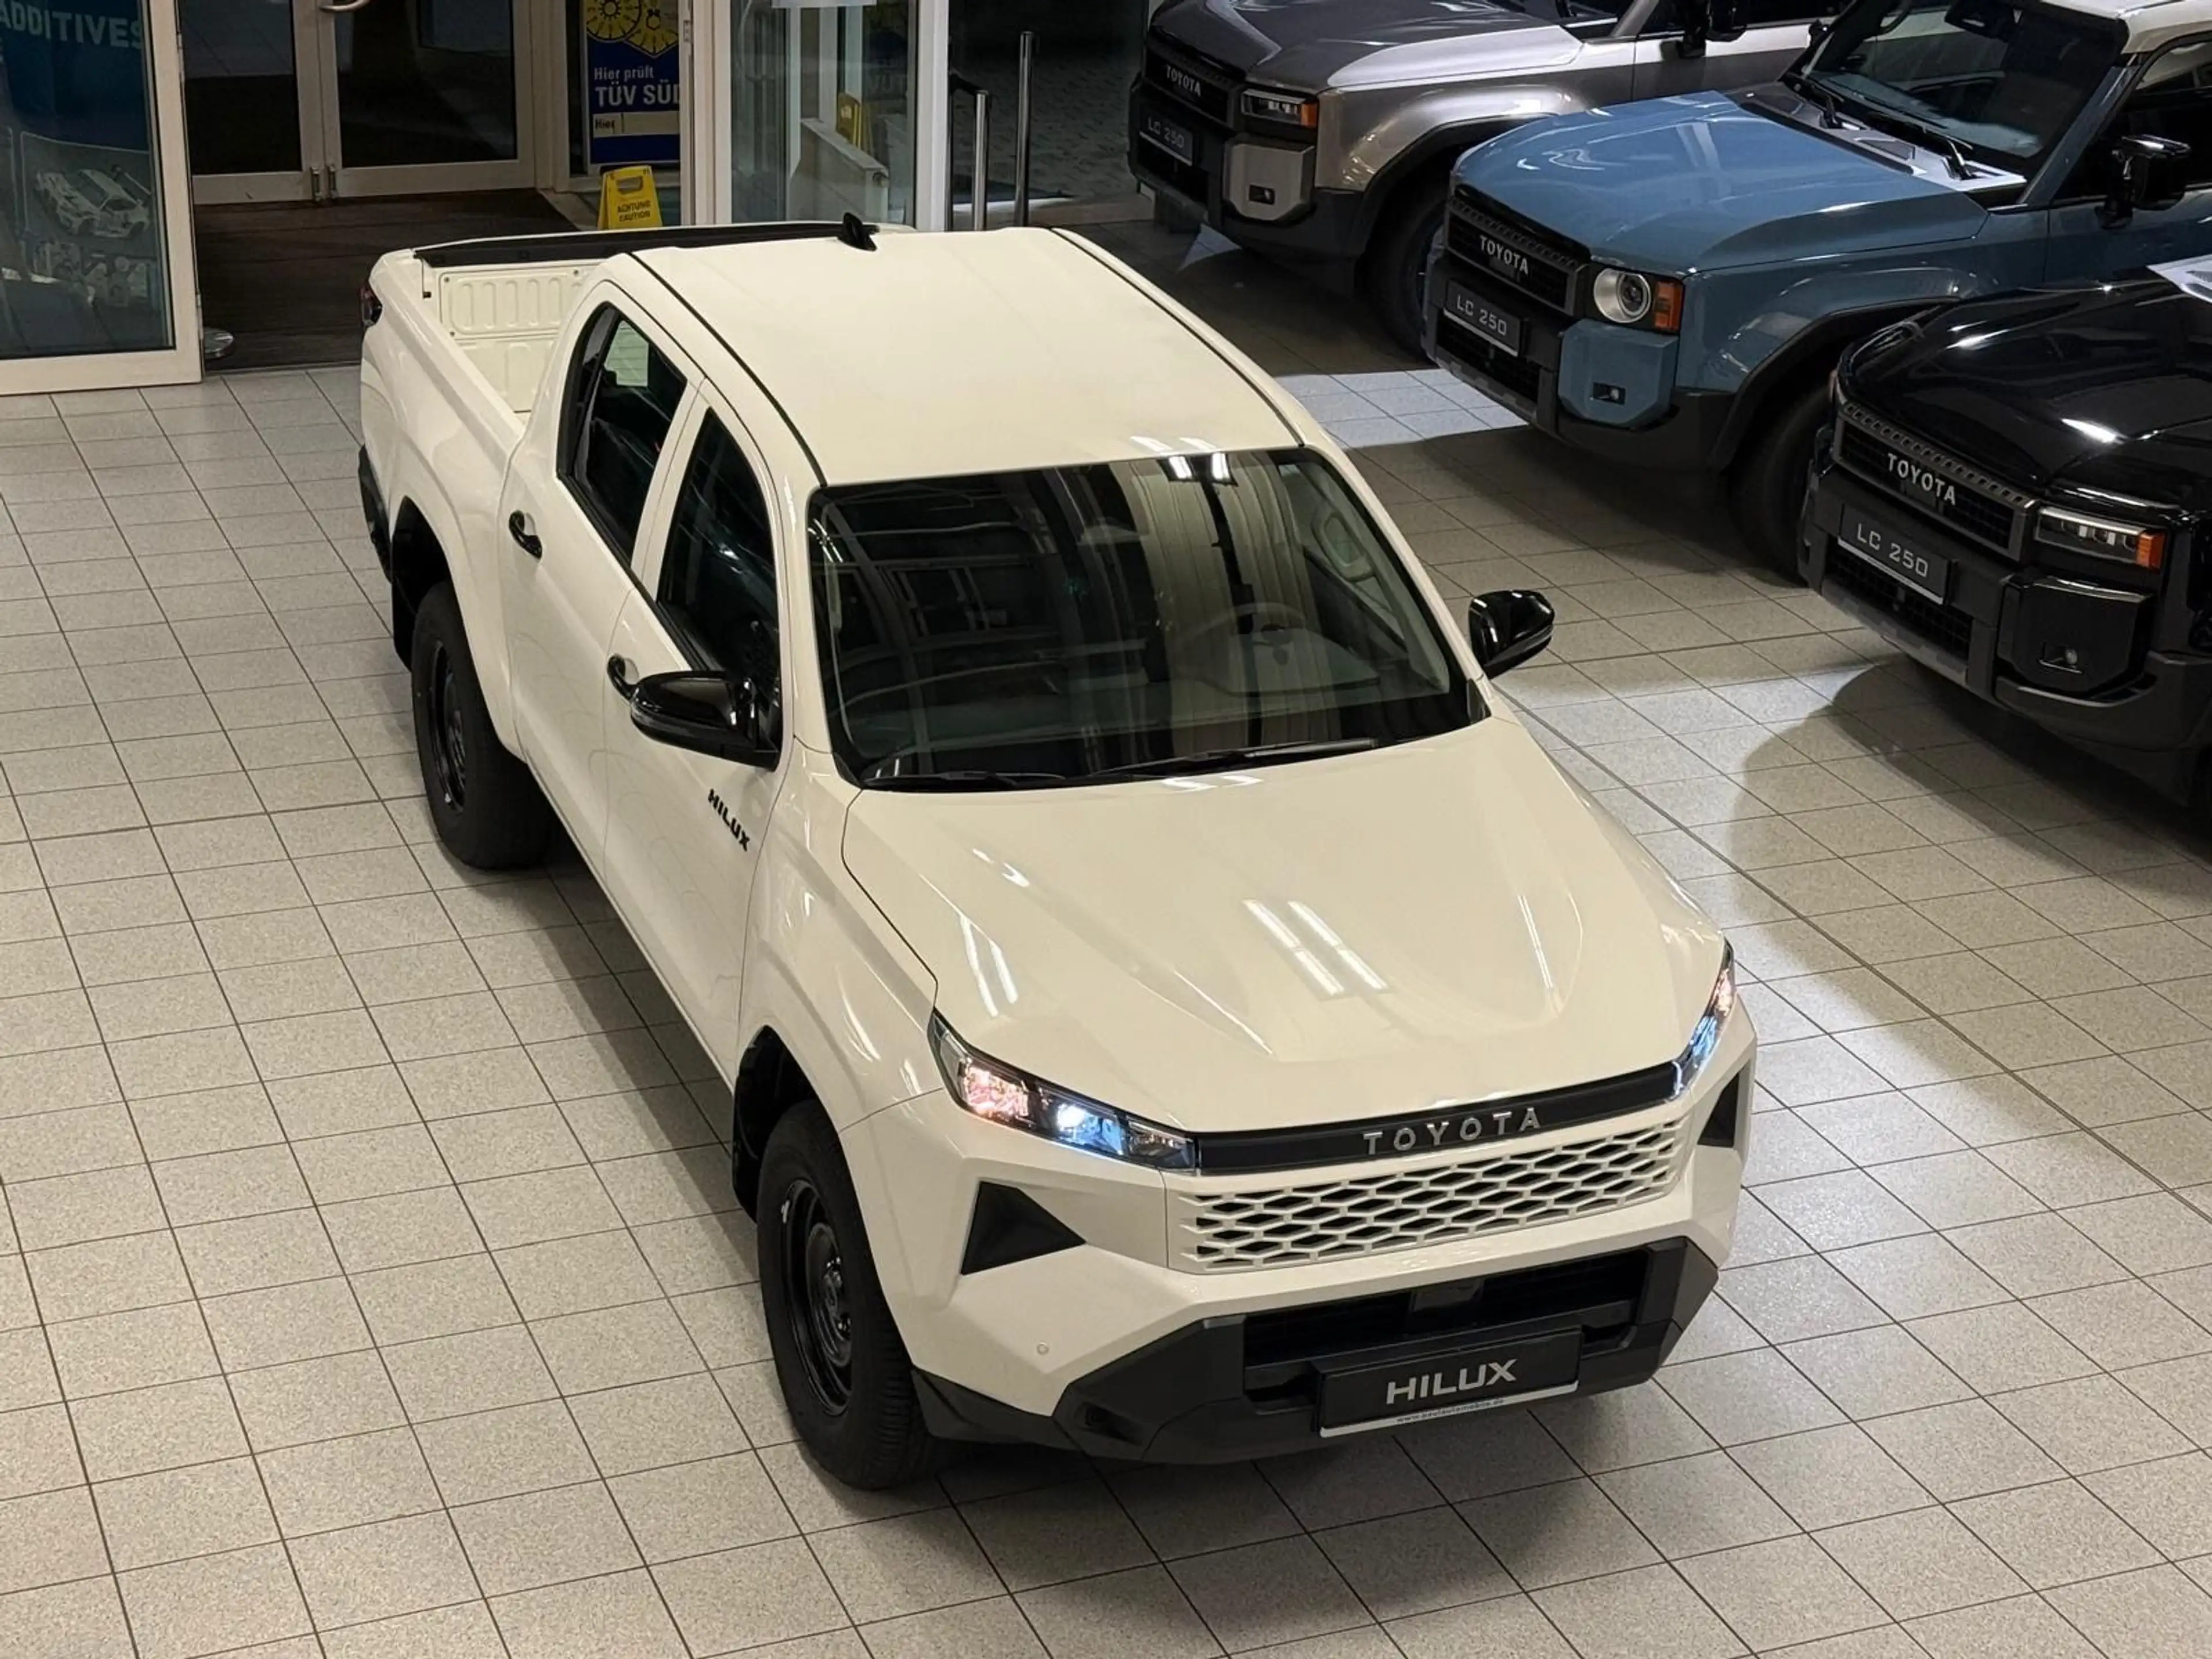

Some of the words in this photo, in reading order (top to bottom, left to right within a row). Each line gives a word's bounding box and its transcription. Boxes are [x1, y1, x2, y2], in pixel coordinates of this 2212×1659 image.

[594, 67, 620, 81] Hier
[624, 65, 654, 82] prüft
[594, 81, 637, 108] TÜV
[1166, 65, 1201, 97] TOYOTA
[1164, 127, 1184, 149] 250
[1479, 235, 1528, 275] TOYOTA
[1457, 294, 1474, 316] LC
[1479, 309, 1507, 336] 250
[1888, 452, 1956, 506] TOYOTA
[1857, 523, 1881, 550] LC
[1889, 543, 1929, 578] 250
[708, 788, 750, 852] HILUX
[1363, 1107, 1540, 1156] TOYOTA
[1386, 1358, 1517, 1405] HILUX
